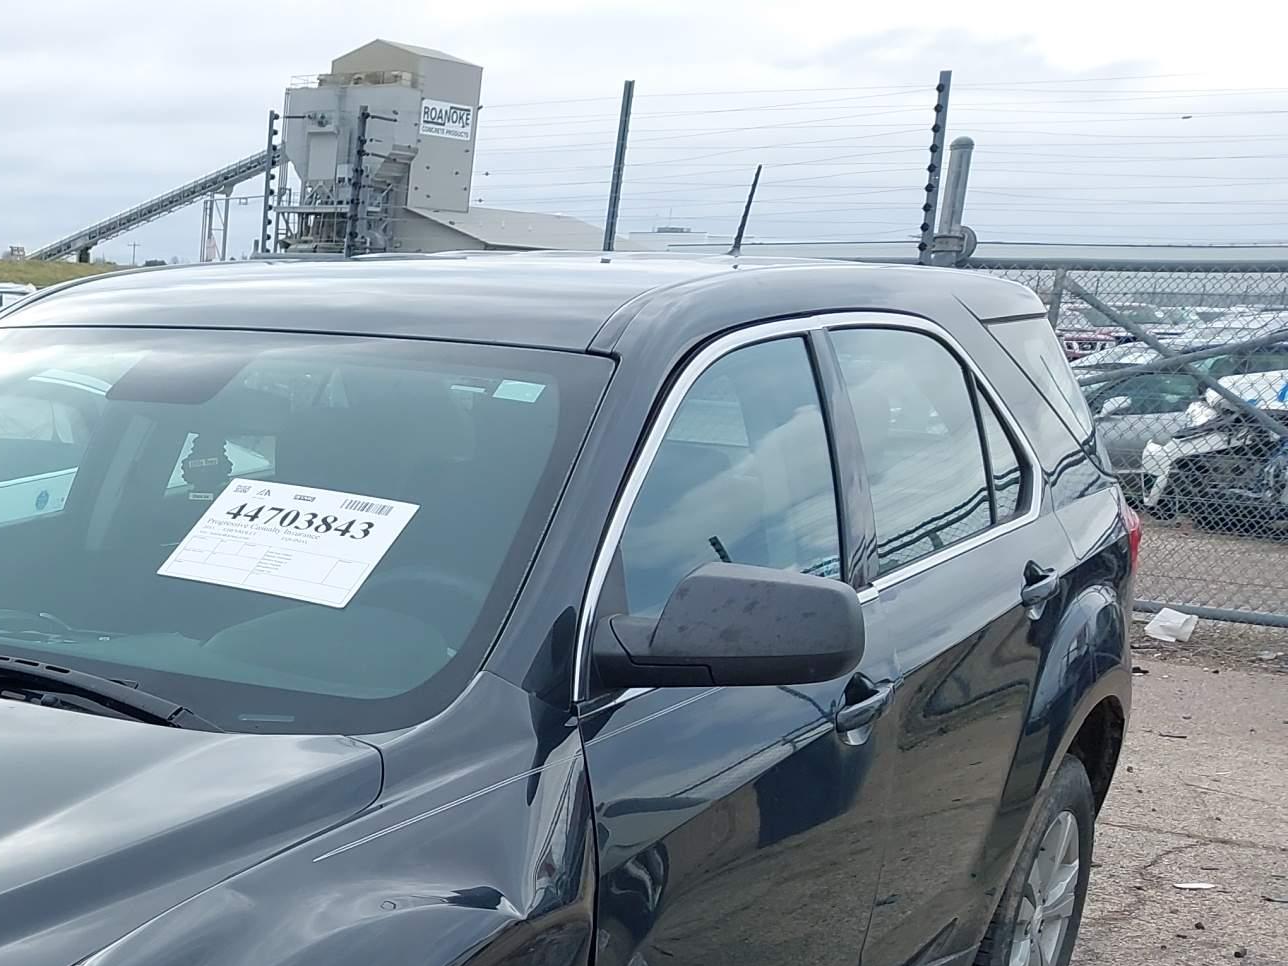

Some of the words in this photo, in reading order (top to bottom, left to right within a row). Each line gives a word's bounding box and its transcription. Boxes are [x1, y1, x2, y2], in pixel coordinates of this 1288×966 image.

[423, 105, 471, 128] ROANOKE
[422, 126, 445, 135] CONCRETE
[445, 129, 469, 139] PRODUCTS
[207, 518, 248, 530] Progressive
[250, 523, 280, 535] Casualty
[283, 528, 321, 540] Insurance
[225, 502, 376, 541] 44703843
